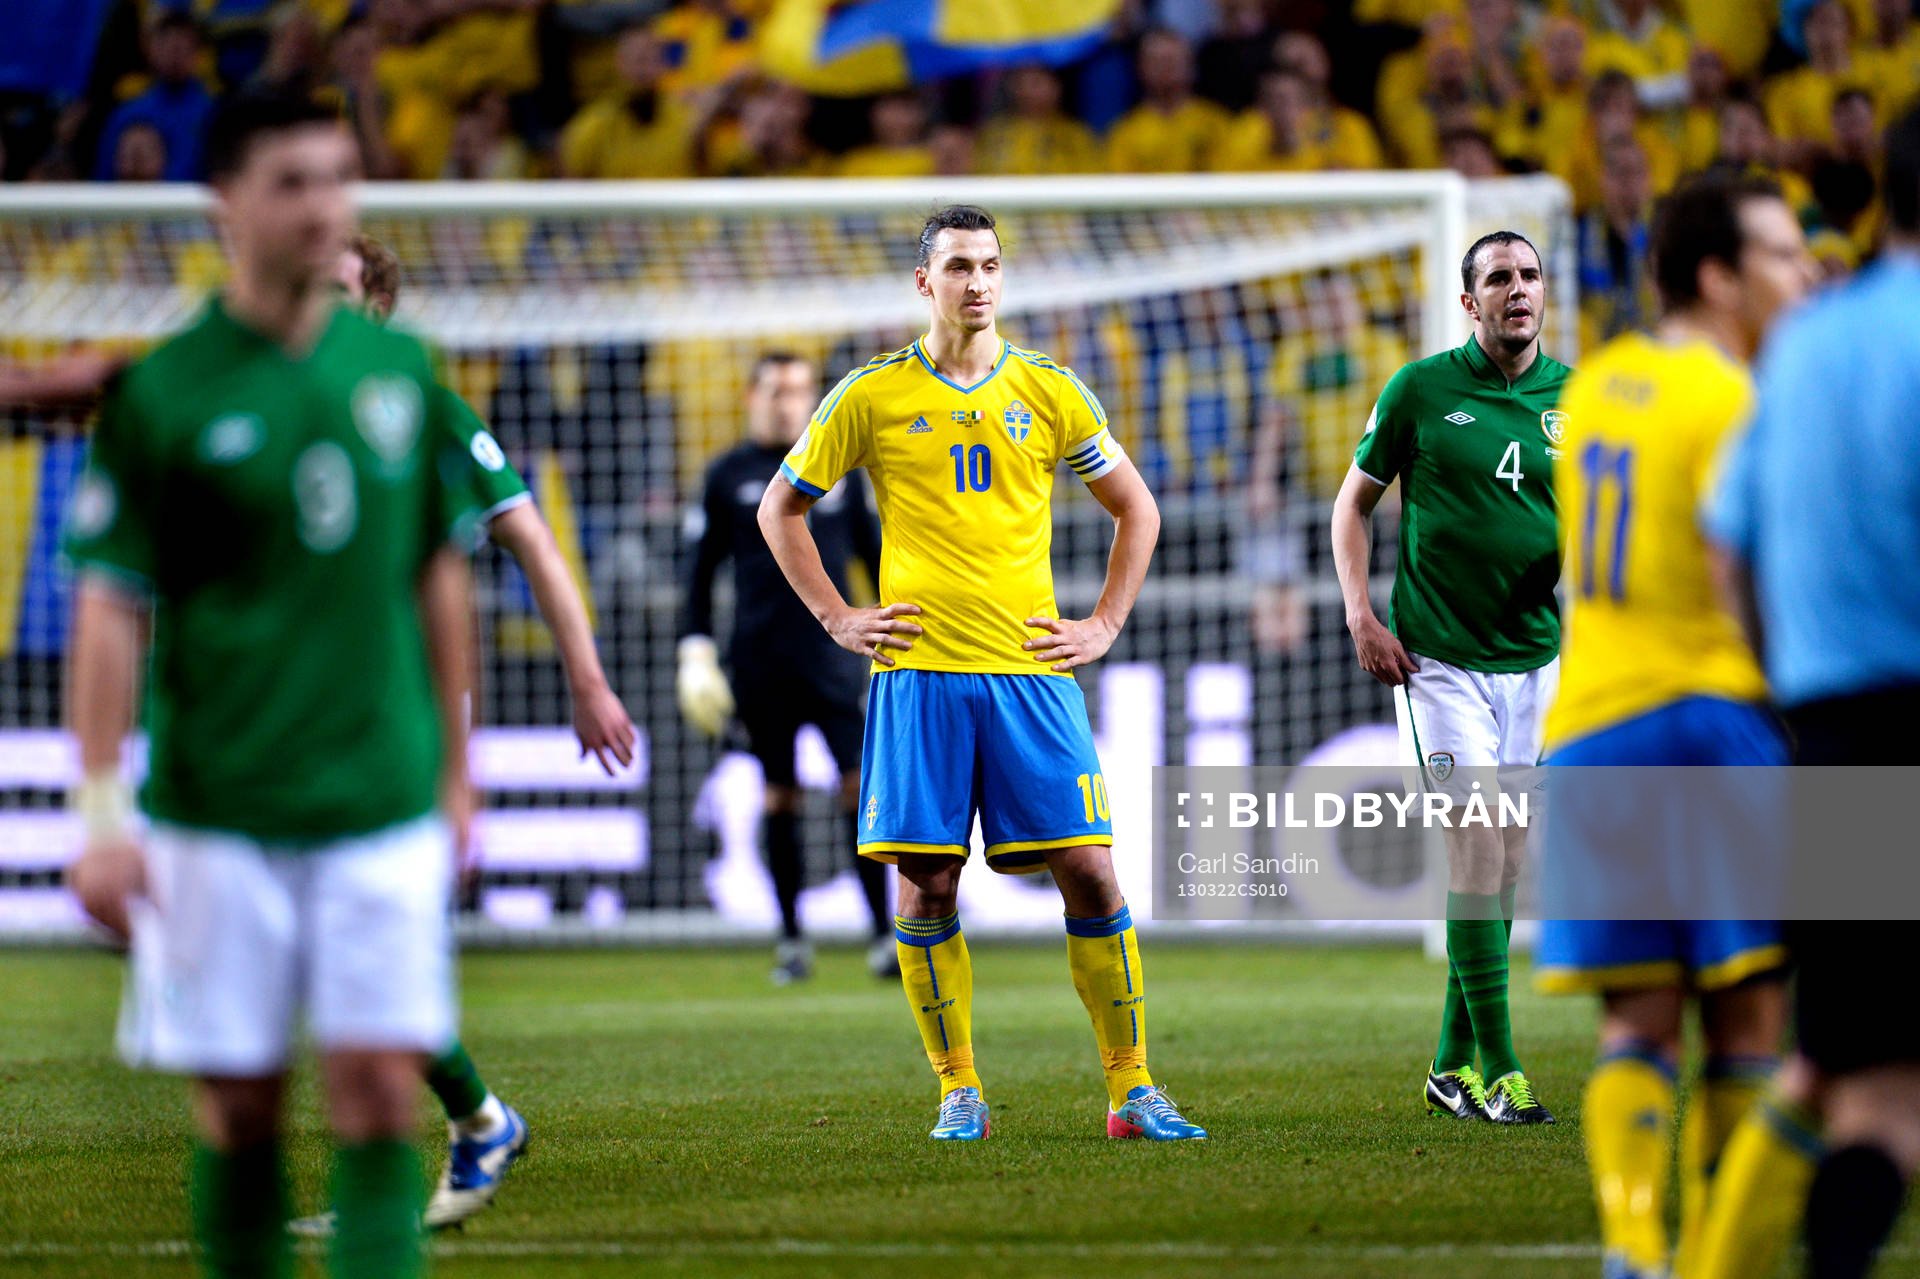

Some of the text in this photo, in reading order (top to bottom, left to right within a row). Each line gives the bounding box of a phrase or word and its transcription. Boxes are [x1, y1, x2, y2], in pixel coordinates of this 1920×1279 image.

[950, 443, 991, 493] 10
[1496, 441, 1524, 492] 4
[1581, 440, 1632, 603] 11
[1077, 773, 1110, 824] 10
